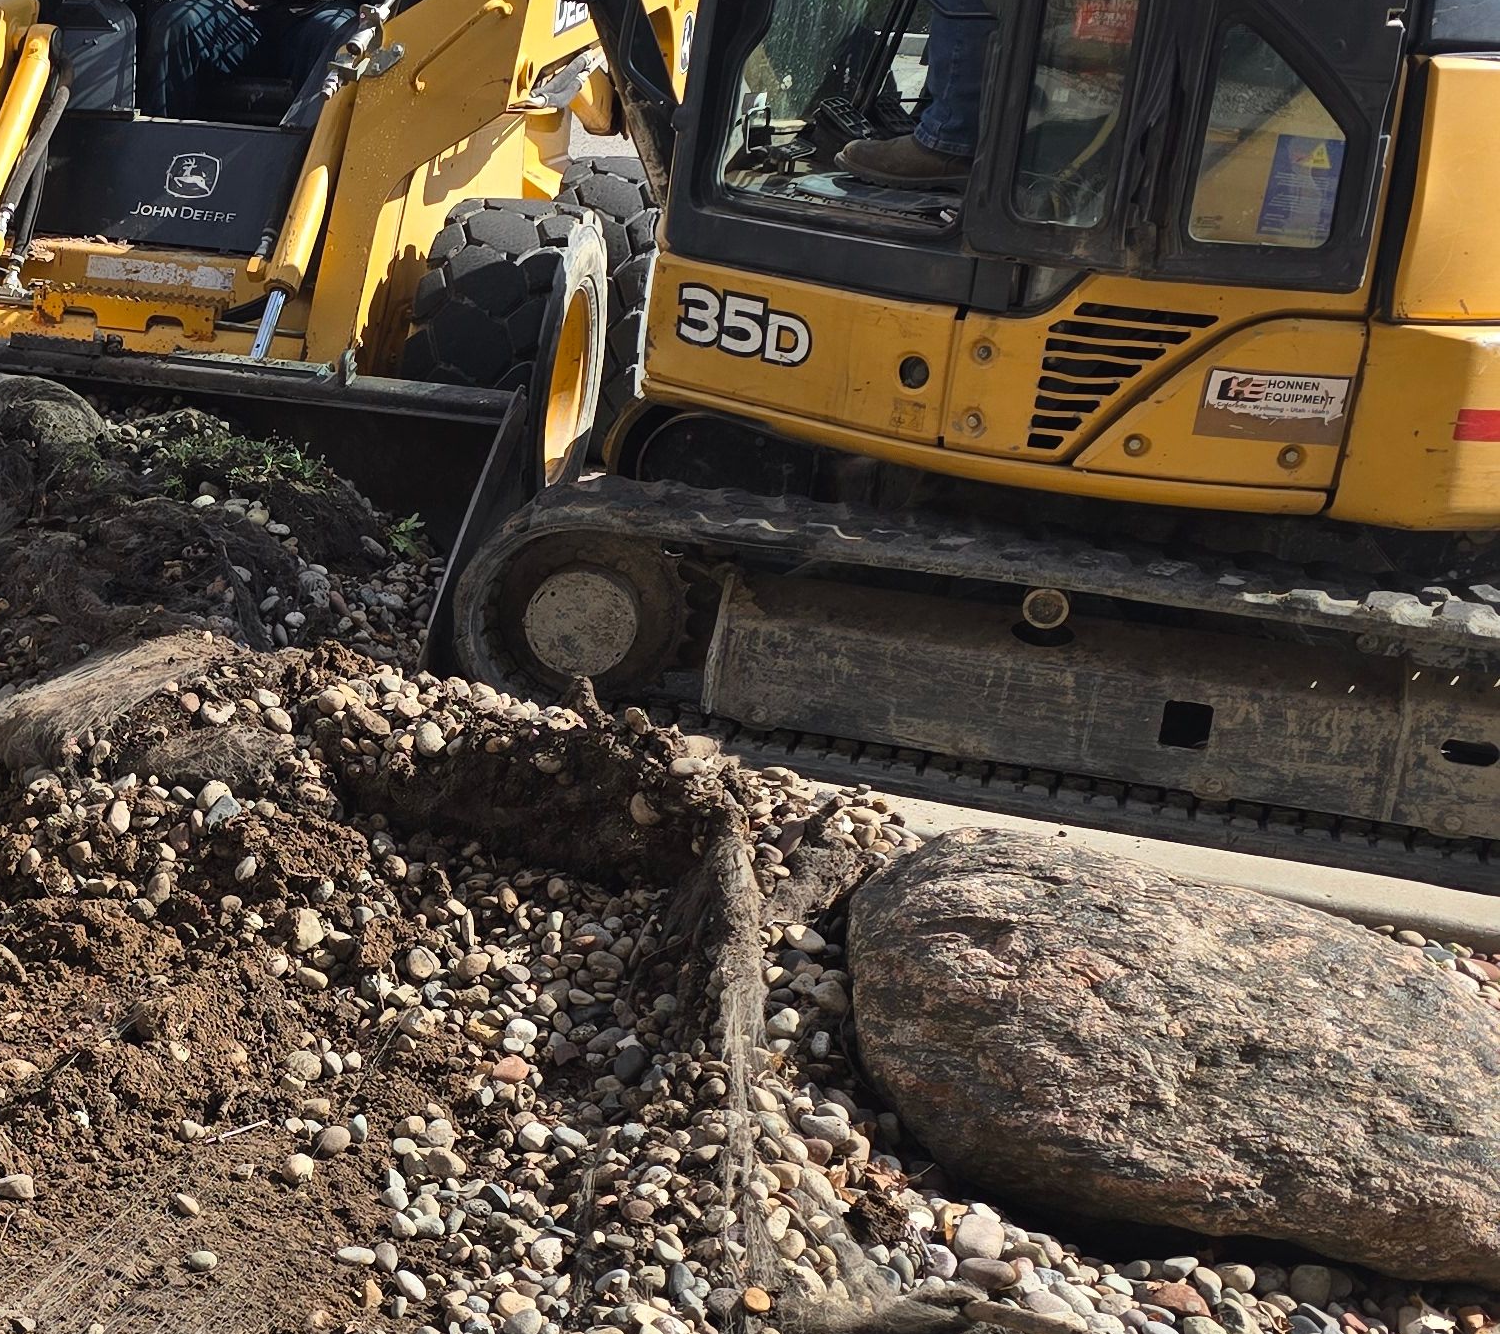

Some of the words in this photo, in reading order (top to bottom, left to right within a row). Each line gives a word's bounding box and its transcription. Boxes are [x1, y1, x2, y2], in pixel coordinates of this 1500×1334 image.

[129, 200, 178, 218] JOHN
[179, 206, 237, 224] DEERE
[677, 283, 812, 366] 35D
[1267, 380, 1320, 391] HONNEN
[1264, 392, 1336, 405] EQUIPMENT
[1252, 404, 1284, 413] Wyoming
